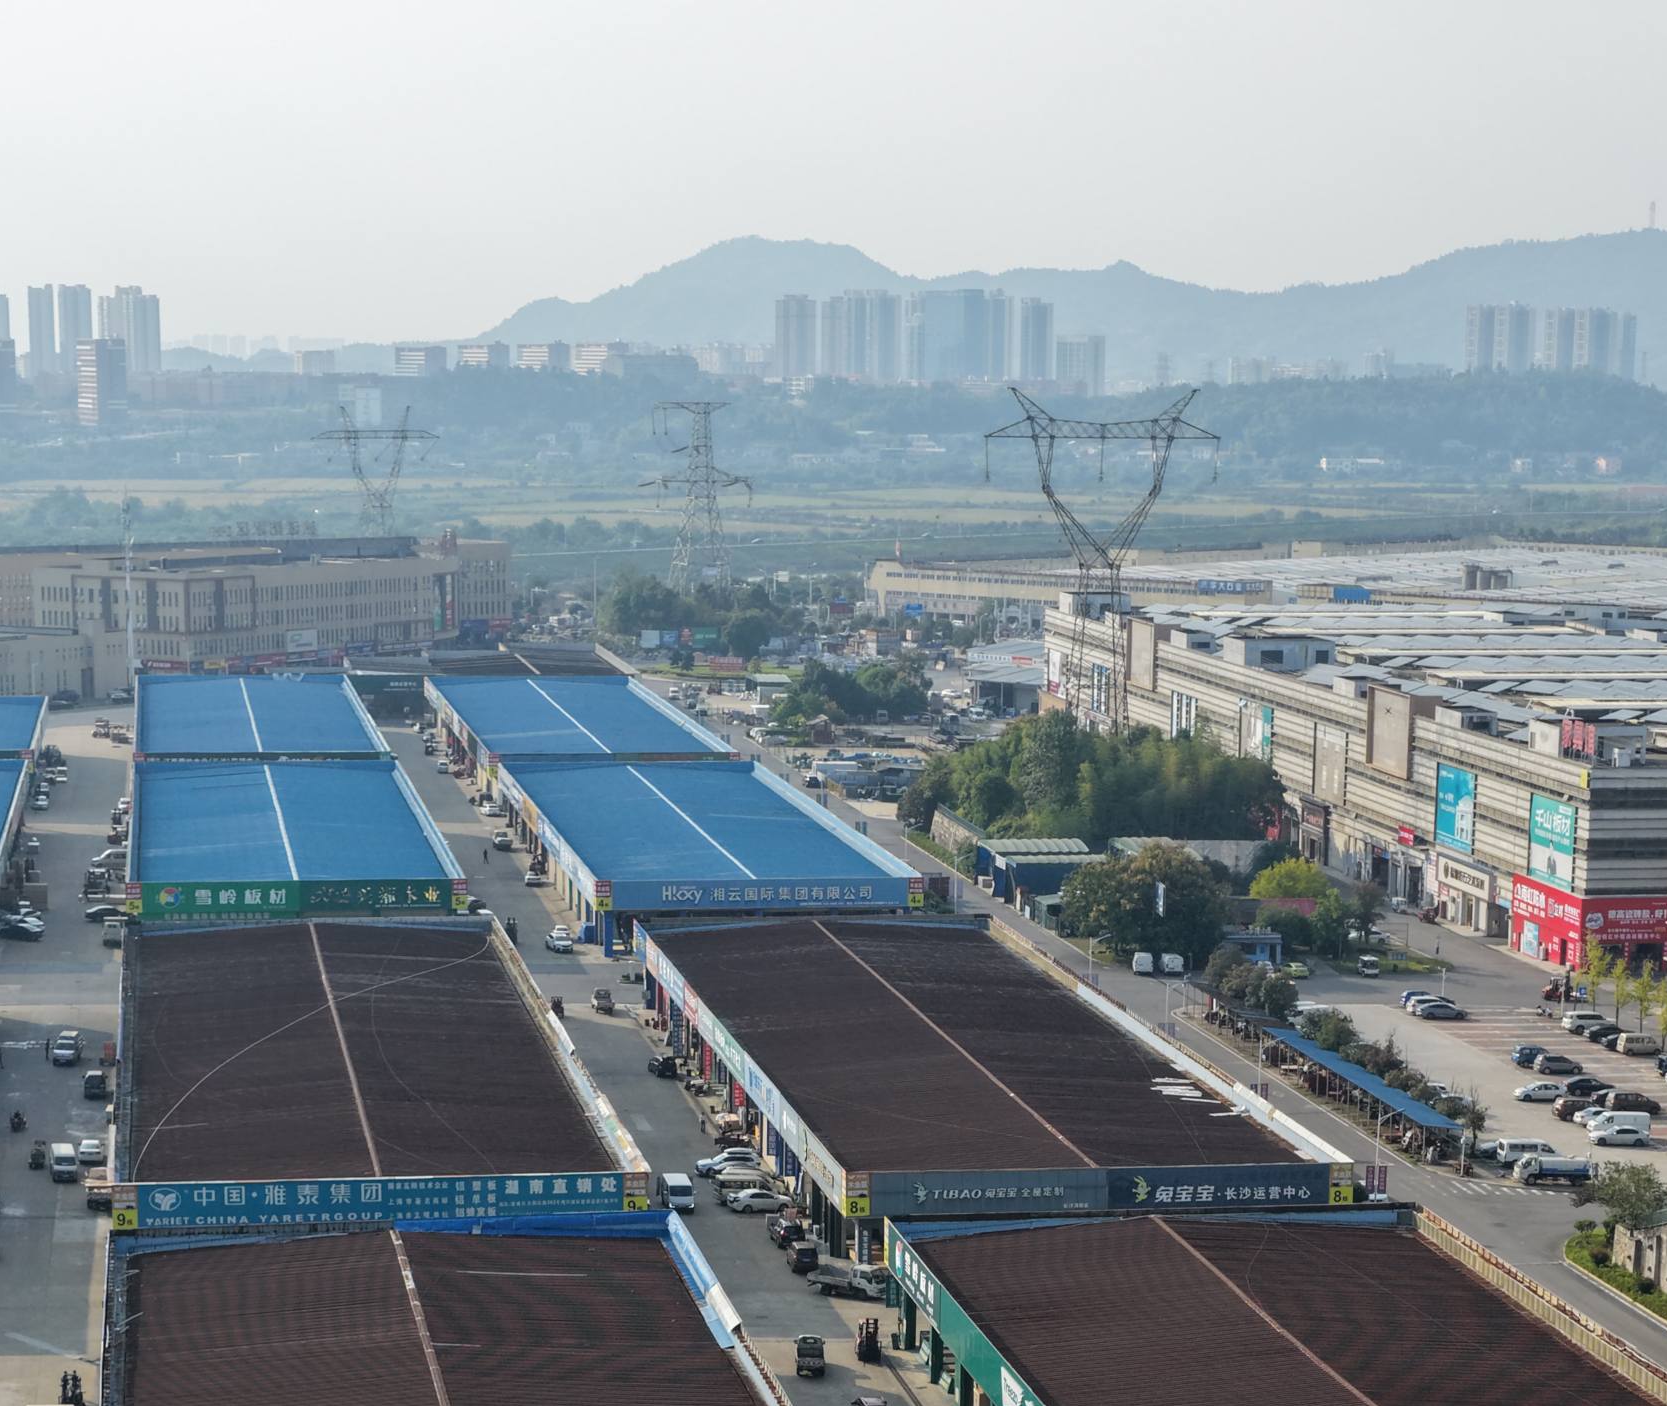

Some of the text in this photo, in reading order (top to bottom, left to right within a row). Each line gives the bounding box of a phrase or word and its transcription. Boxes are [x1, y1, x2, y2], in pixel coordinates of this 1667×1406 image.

[193, 888, 288, 906] 雪岭板材
[710, 886, 874, 902] 湘云国际集团有限公司
[193, 1183, 384, 1205] 中国·雅泰集团
[505, 1178, 617, 1195] 湖南直销处
[1154, 1184, 1311, 1204] 兔宝宝·长沙运营中心
[196, 1211, 253, 1223] CHINA
